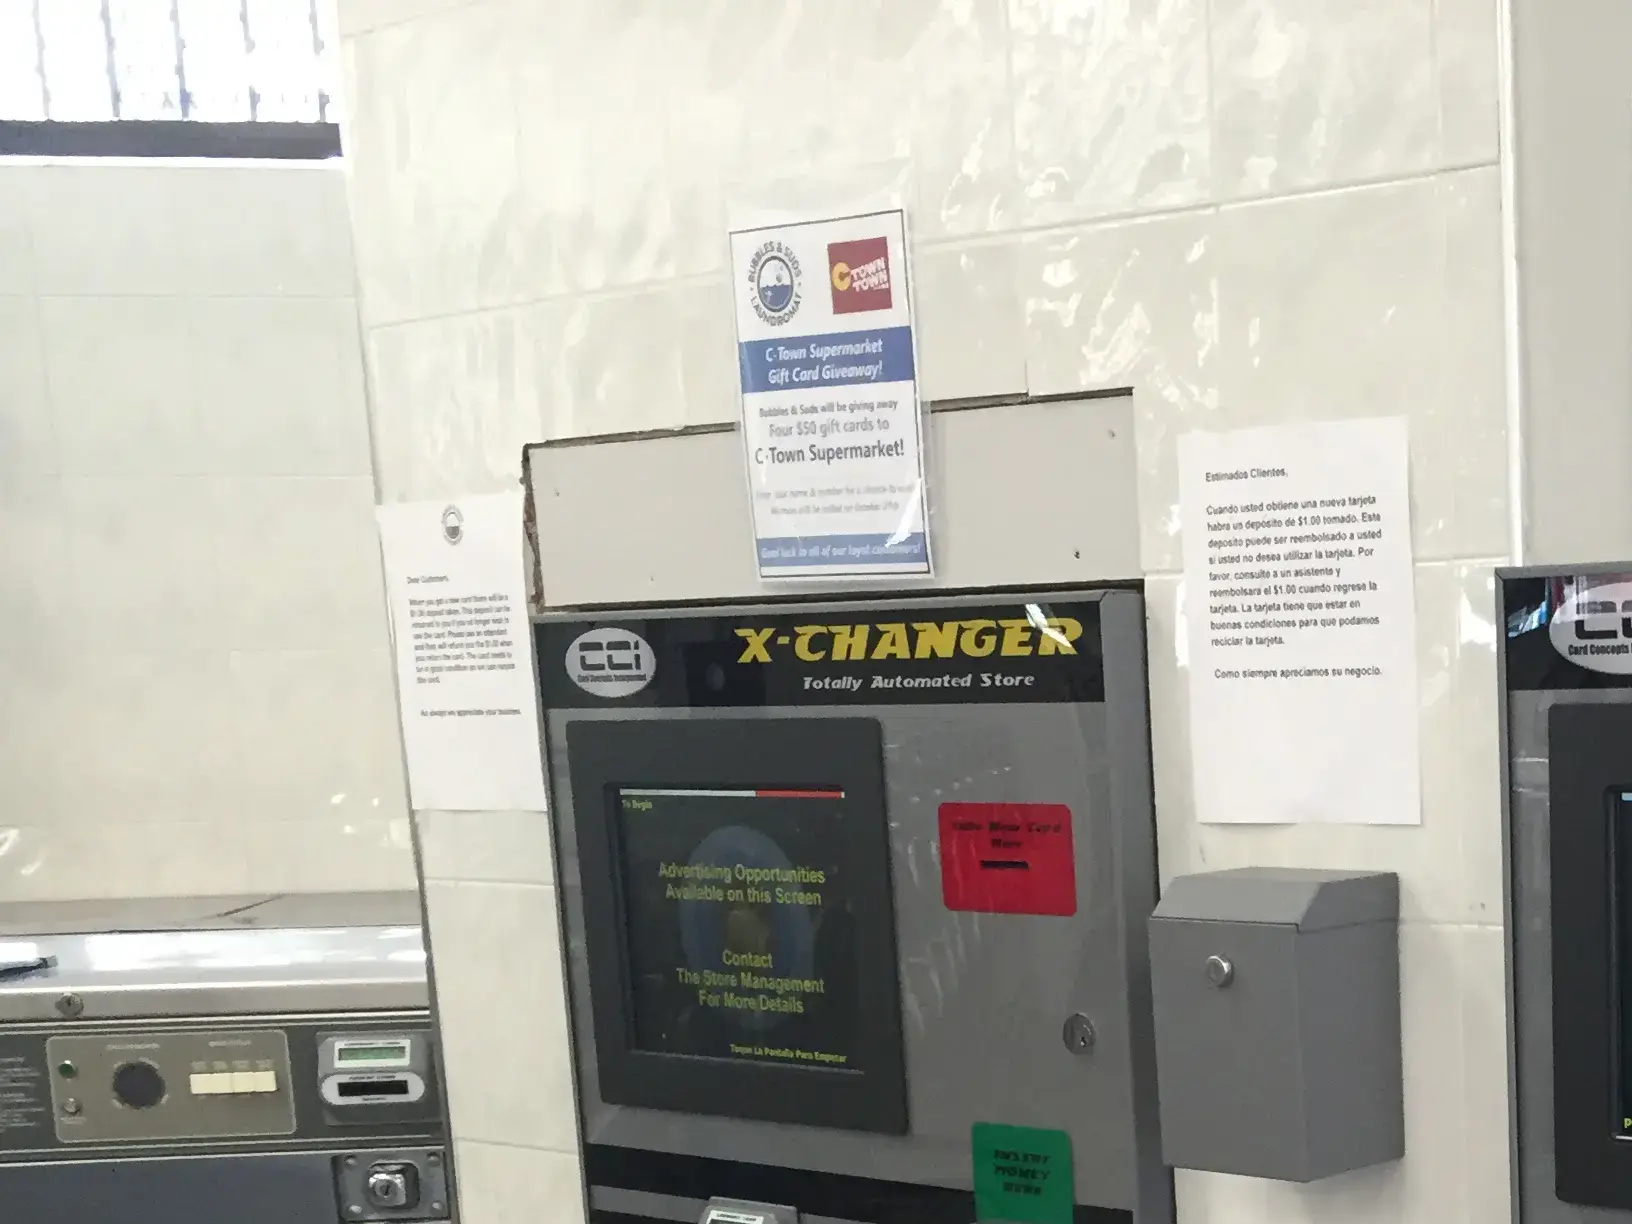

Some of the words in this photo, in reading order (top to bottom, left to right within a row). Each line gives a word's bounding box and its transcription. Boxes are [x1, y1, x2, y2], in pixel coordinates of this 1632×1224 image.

[765, 346, 807, 363] C-Town
[809, 338, 883, 362] Supermarket
[768, 367, 789, 386] Gift
[792, 364, 820, 382] Card
[821, 360, 883, 380] Giveaway!
[755, 446, 805, 465] C-Town
[808, 438, 905, 466] Supermarket!
[735, 617, 1083, 662] X-CHANGER
[803, 676, 863, 692] Totally
[870, 673, 973, 689] Automated
[980, 672, 1035, 687] Store
